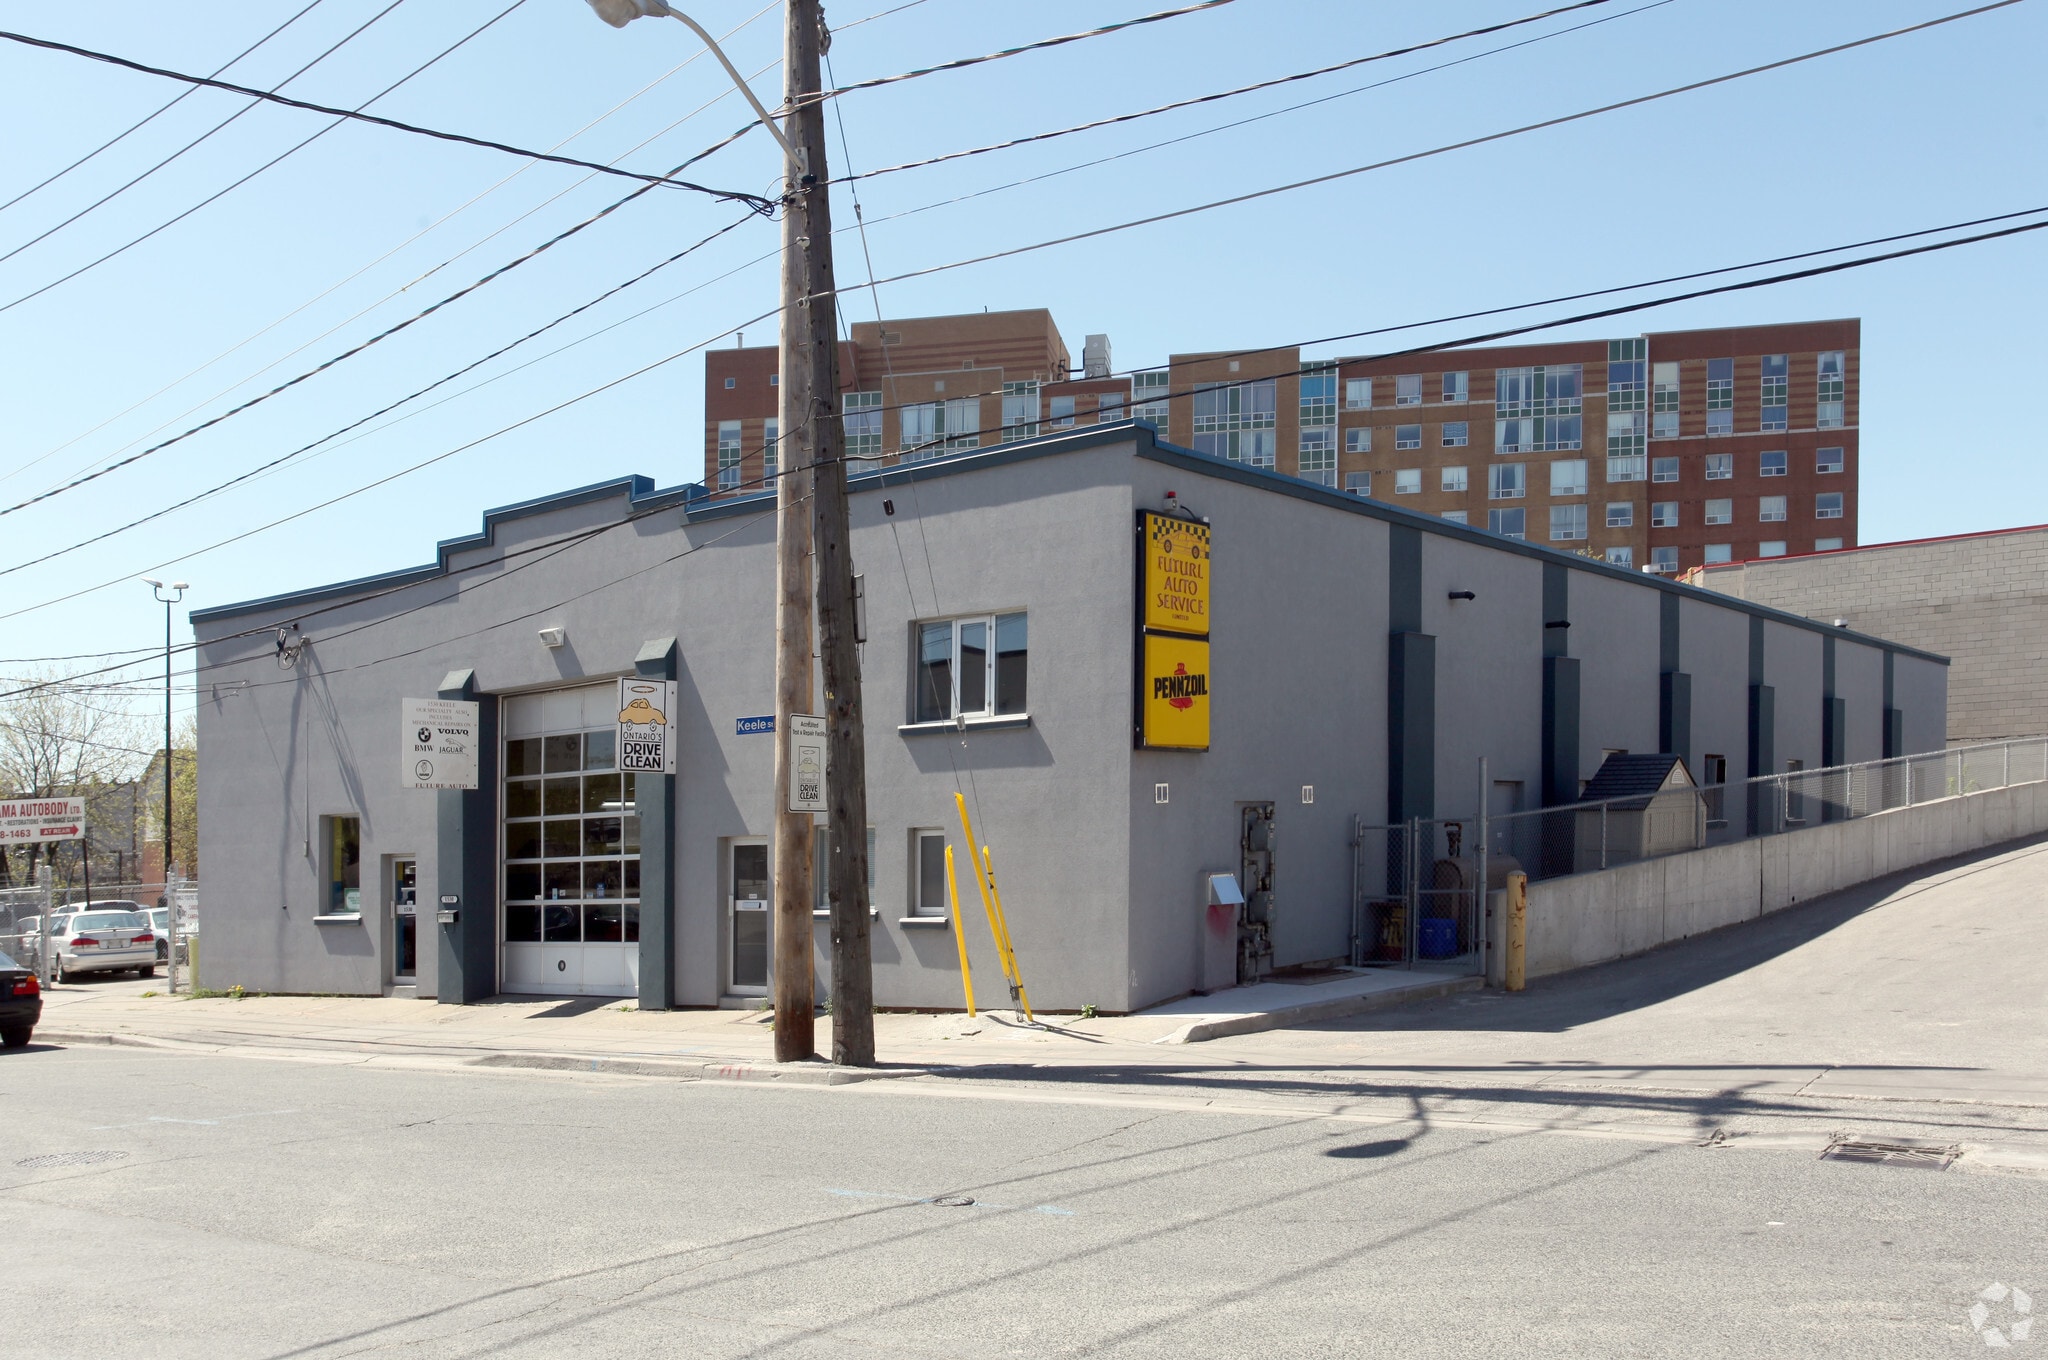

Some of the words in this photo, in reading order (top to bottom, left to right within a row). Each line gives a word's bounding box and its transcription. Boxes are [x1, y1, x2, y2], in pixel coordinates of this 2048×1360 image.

[1164, 576, 1198, 595] AUTO
[1157, 593, 1204, 615] SERVICE
[1154, 674, 1207, 699] PENNZOIL
[738, 719, 767, 731] Keele
[623, 731, 662, 741] ONTARIO'S
[414, 744, 434, 752] BMW
[439, 746, 464, 754] JAGUAR
[624, 742, 661, 756] DRIVE
[623, 755, 661, 768] CLEAN
[800, 784, 818, 792] DRIVE
[800, 791, 818, 800] CLEAN
[20, 801, 69, 817] AUTOBODY
